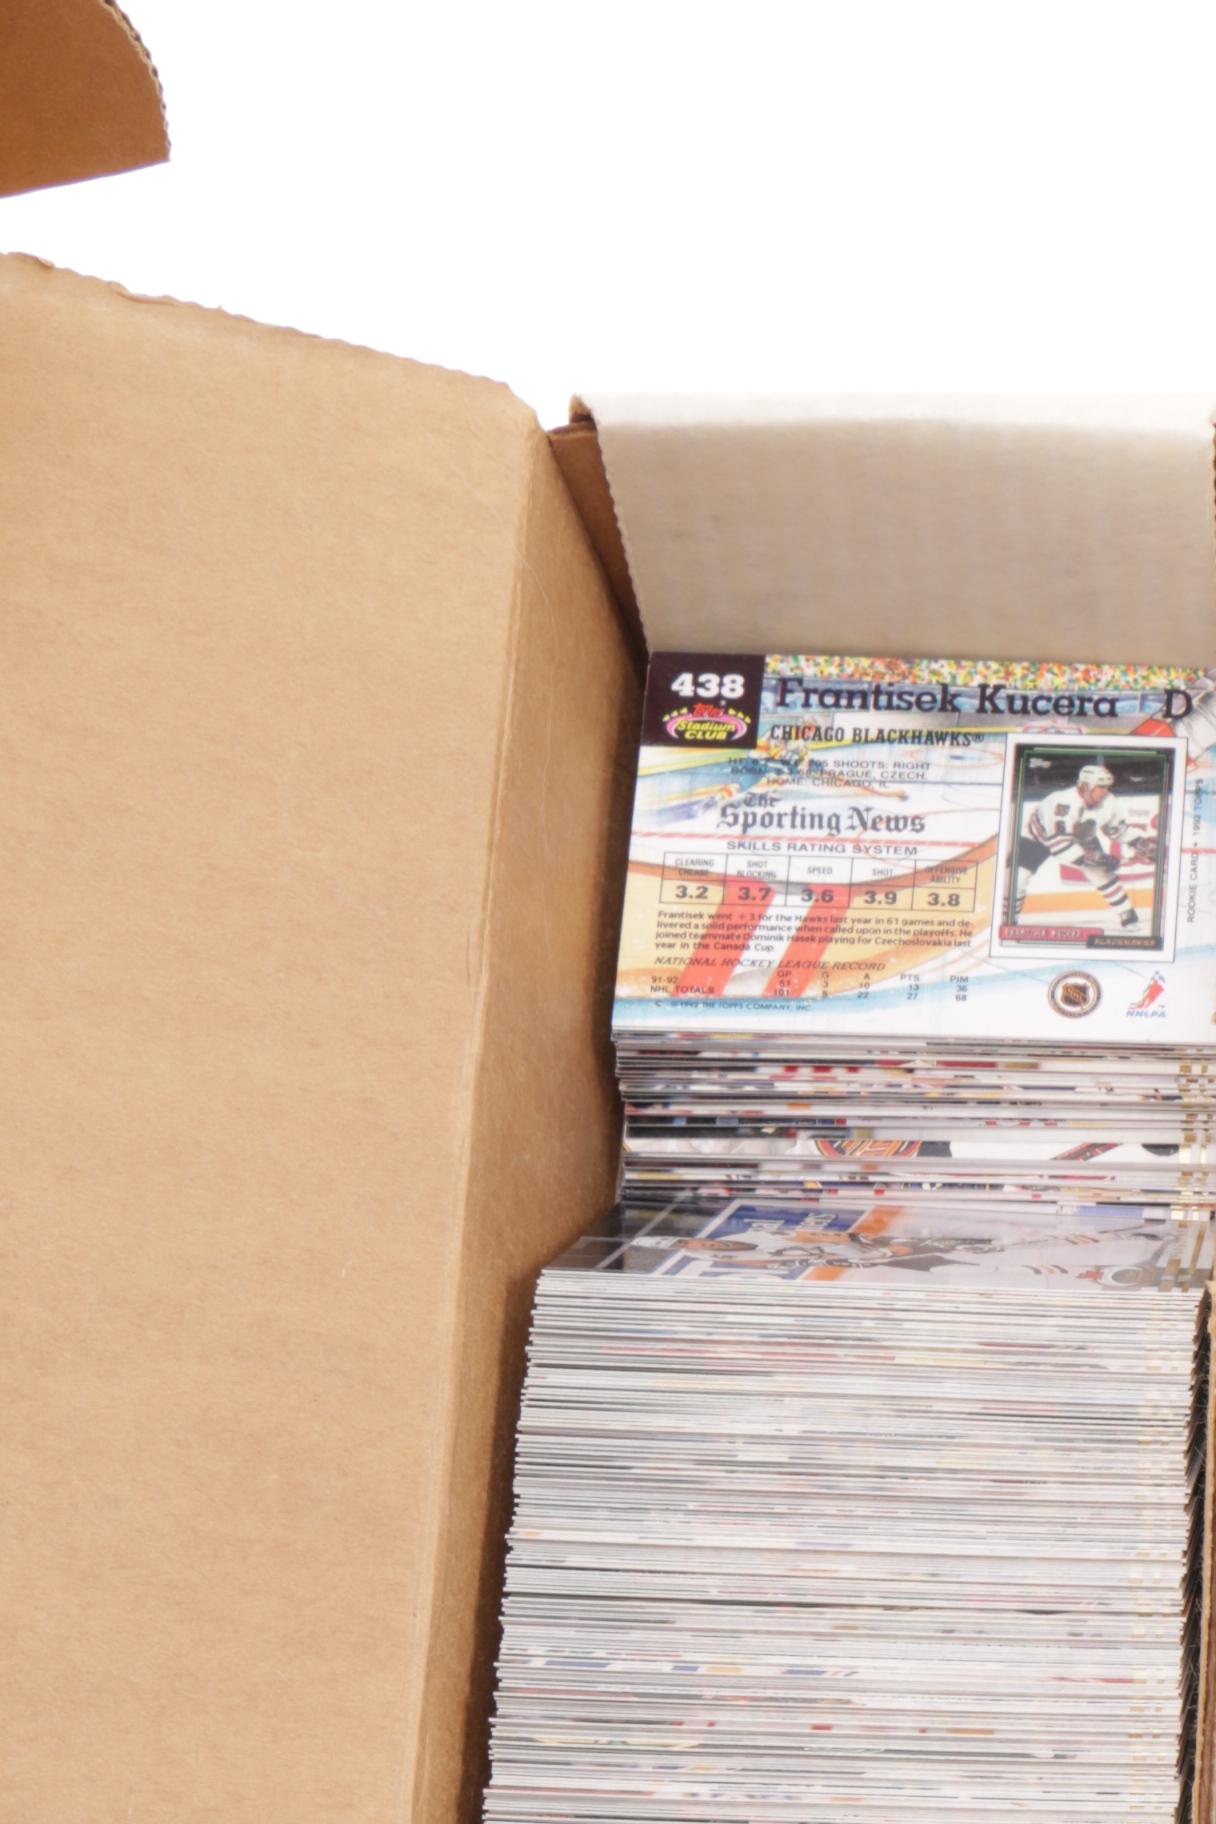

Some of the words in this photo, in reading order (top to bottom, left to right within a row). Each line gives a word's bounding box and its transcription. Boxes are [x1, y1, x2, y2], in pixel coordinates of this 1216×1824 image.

[671, 672, 745, 699] 438
[776, 677, 961, 713] Frantisek
[976, 683, 1119, 718] Kucera
[1163, 689, 1194, 719] D
[677, 720, 736, 732] Stadium
[770, 724, 845, 742] CHICAGO
[684, 729, 727, 740] CLUB
[834, 760, 888, 770] SHOOTS:
[893, 761, 932, 771] RIGHT
[743, 792, 783, 808] The
[717, 803, 842, 837] Sporting
[846, 805, 927, 834] News
[727, 841, 782, 851] SKILLS
[787, 842, 846, 854] RATING
[852, 844, 918, 855] SYSTEM
[807, 866, 832, 874] SPEED
[1190, 849, 1200, 881] CARD
[675, 885, 709, 900] 3.2
[737, 887, 772, 901] 3.7
[800, 888, 834, 903] 3.6
[864, 890, 897, 905] 3.9
[927, 892, 961, 907] 3.8
[1187, 884, 1198, 923] ROOKIE
[658, 911, 704, 920] Frantisek
[720, 958, 775, 968] HOCKEY
[777, 960, 830, 970] LEAGUE
[832, 961, 886, 971] RECORD
[900, 974, 920, 982] PTS
[950, 975, 969, 983] PIM
